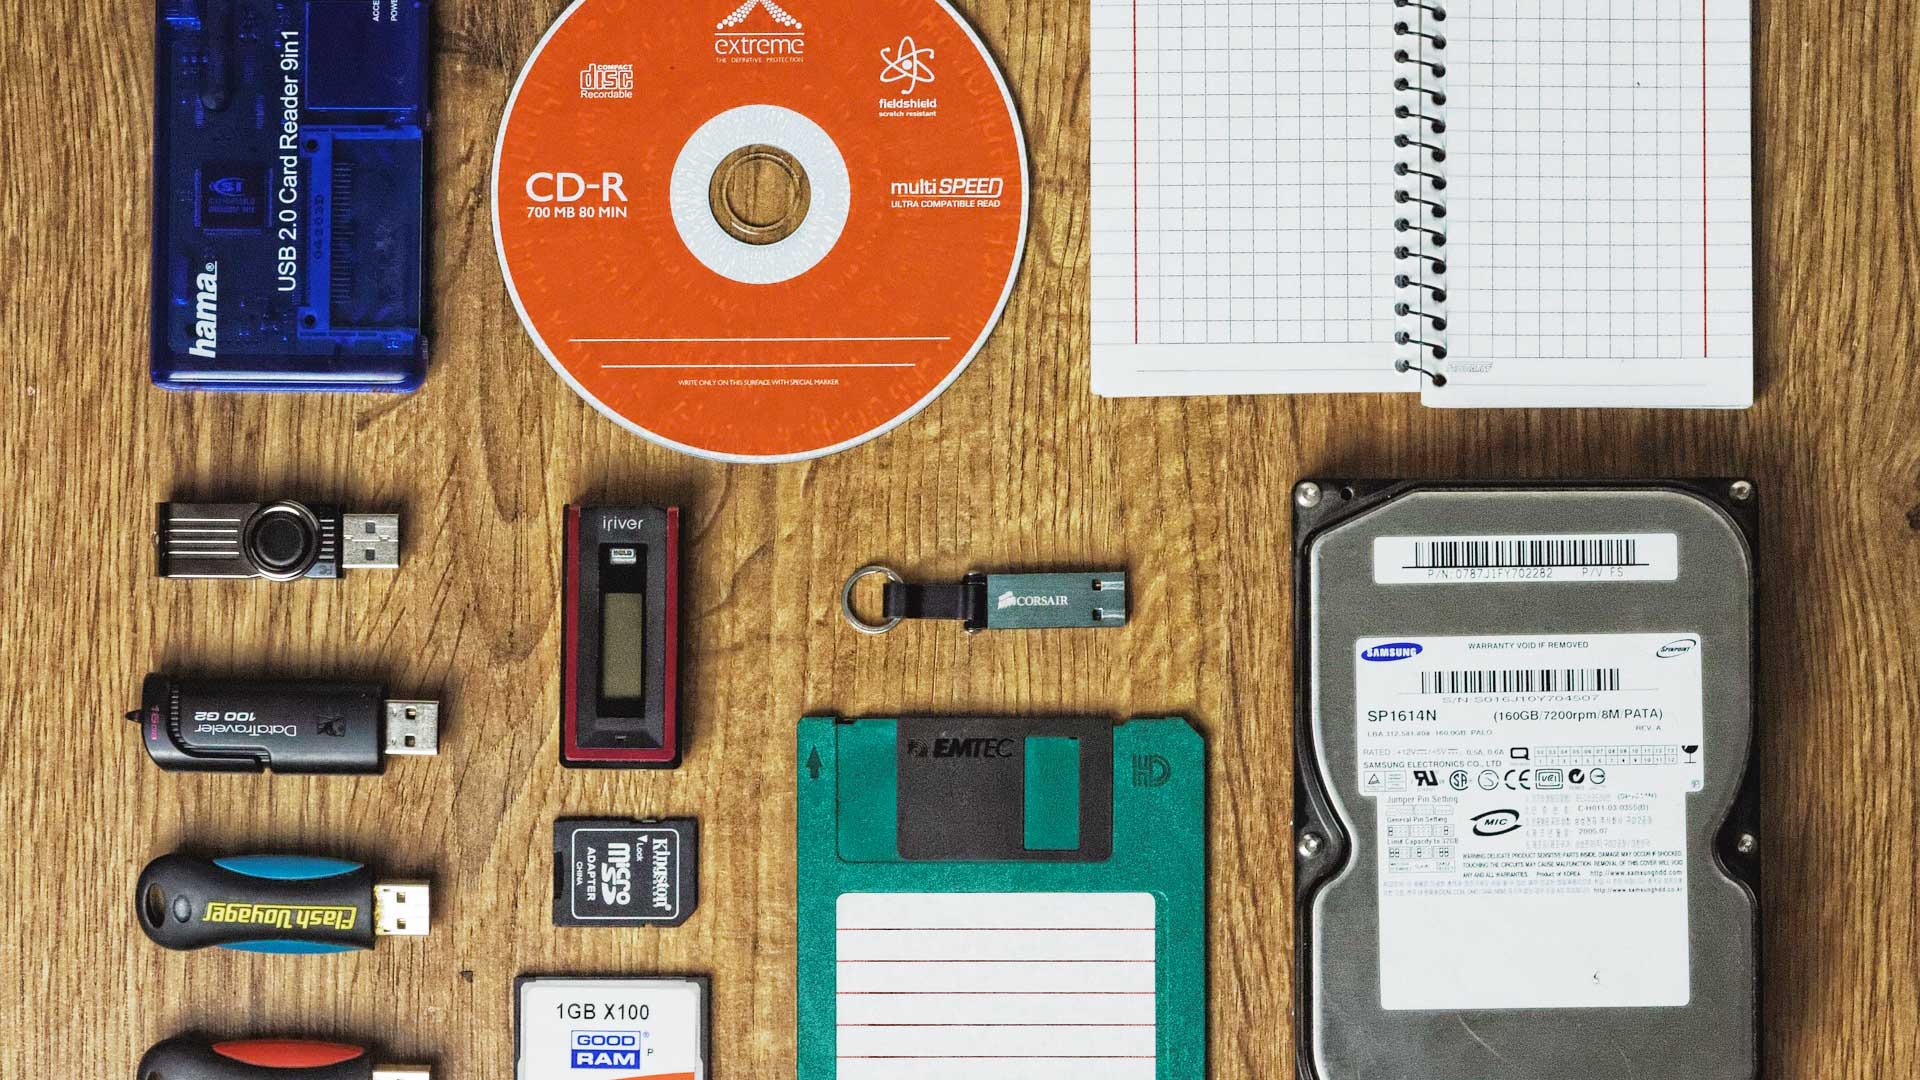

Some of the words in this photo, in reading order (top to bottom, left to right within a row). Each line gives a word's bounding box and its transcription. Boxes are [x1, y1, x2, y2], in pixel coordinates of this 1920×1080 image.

[280, 31, 299, 74] 9in1
[714, 36, 805, 55] extreme
[580, 90, 633, 99] Recordable
[878, 98, 937, 109] fieldshield
[279, 77, 299, 151] Reader
[279, 155, 298, 204] Card
[525, 171, 629, 203] CD-R
[891, 178, 937, 195] multi
[938, 177, 1004, 198] SPEED
[526, 206, 551, 218] 700
[554, 206, 576, 218] MB
[578, 206, 595, 218] 80
[598, 206, 628, 218] MIN
[891, 200, 920, 208] ULTRA
[920, 200, 975, 208] COMPATIBLE
[976, 199, 1001, 207] READ
[279, 209, 298, 241] 2.0
[278, 246, 297, 292] USB
[189, 271, 217, 358] hama
[602, 515, 644, 532] iriver
[1016, 595, 1069, 607] CORSAIR
[1366, 646, 1418, 659] SAMSUNG
[1468, 642, 1515, 650] WARRANTY
[1516, 641, 1537, 649] VOID
[1538, 641, 1546, 649] IF
[1548, 641, 1589, 649] REMOVED
[194, 711, 220, 722] G2
[224, 711, 256, 722] 100
[1367, 709, 1437, 722] SP1614N
[194, 723, 297, 737] DataTraveler
[932, 737, 1017, 759] EMTEC
[1363, 761, 1405, 769] SAMSUNG
[1407, 760, 1465, 768] ELECTRONICS
[1484, 818, 1508, 826] MIC
[636, 842, 644, 862] Lock
[576, 861, 584, 886] CHINA
[587, 846, 597, 901] ADAPTER
[607, 842, 631, 906] micro
[652, 838, 671, 908] Kingston
[203, 901, 292, 929] Voyager
[295, 905, 358, 930] Flash
[557, 1003, 596, 1020] 1GB
[603, 1003, 650, 1021] X100
[577, 1034, 636, 1046] GOOD
[577, 1052, 636, 1066] RAM
[647, 1048, 654, 1057] P
